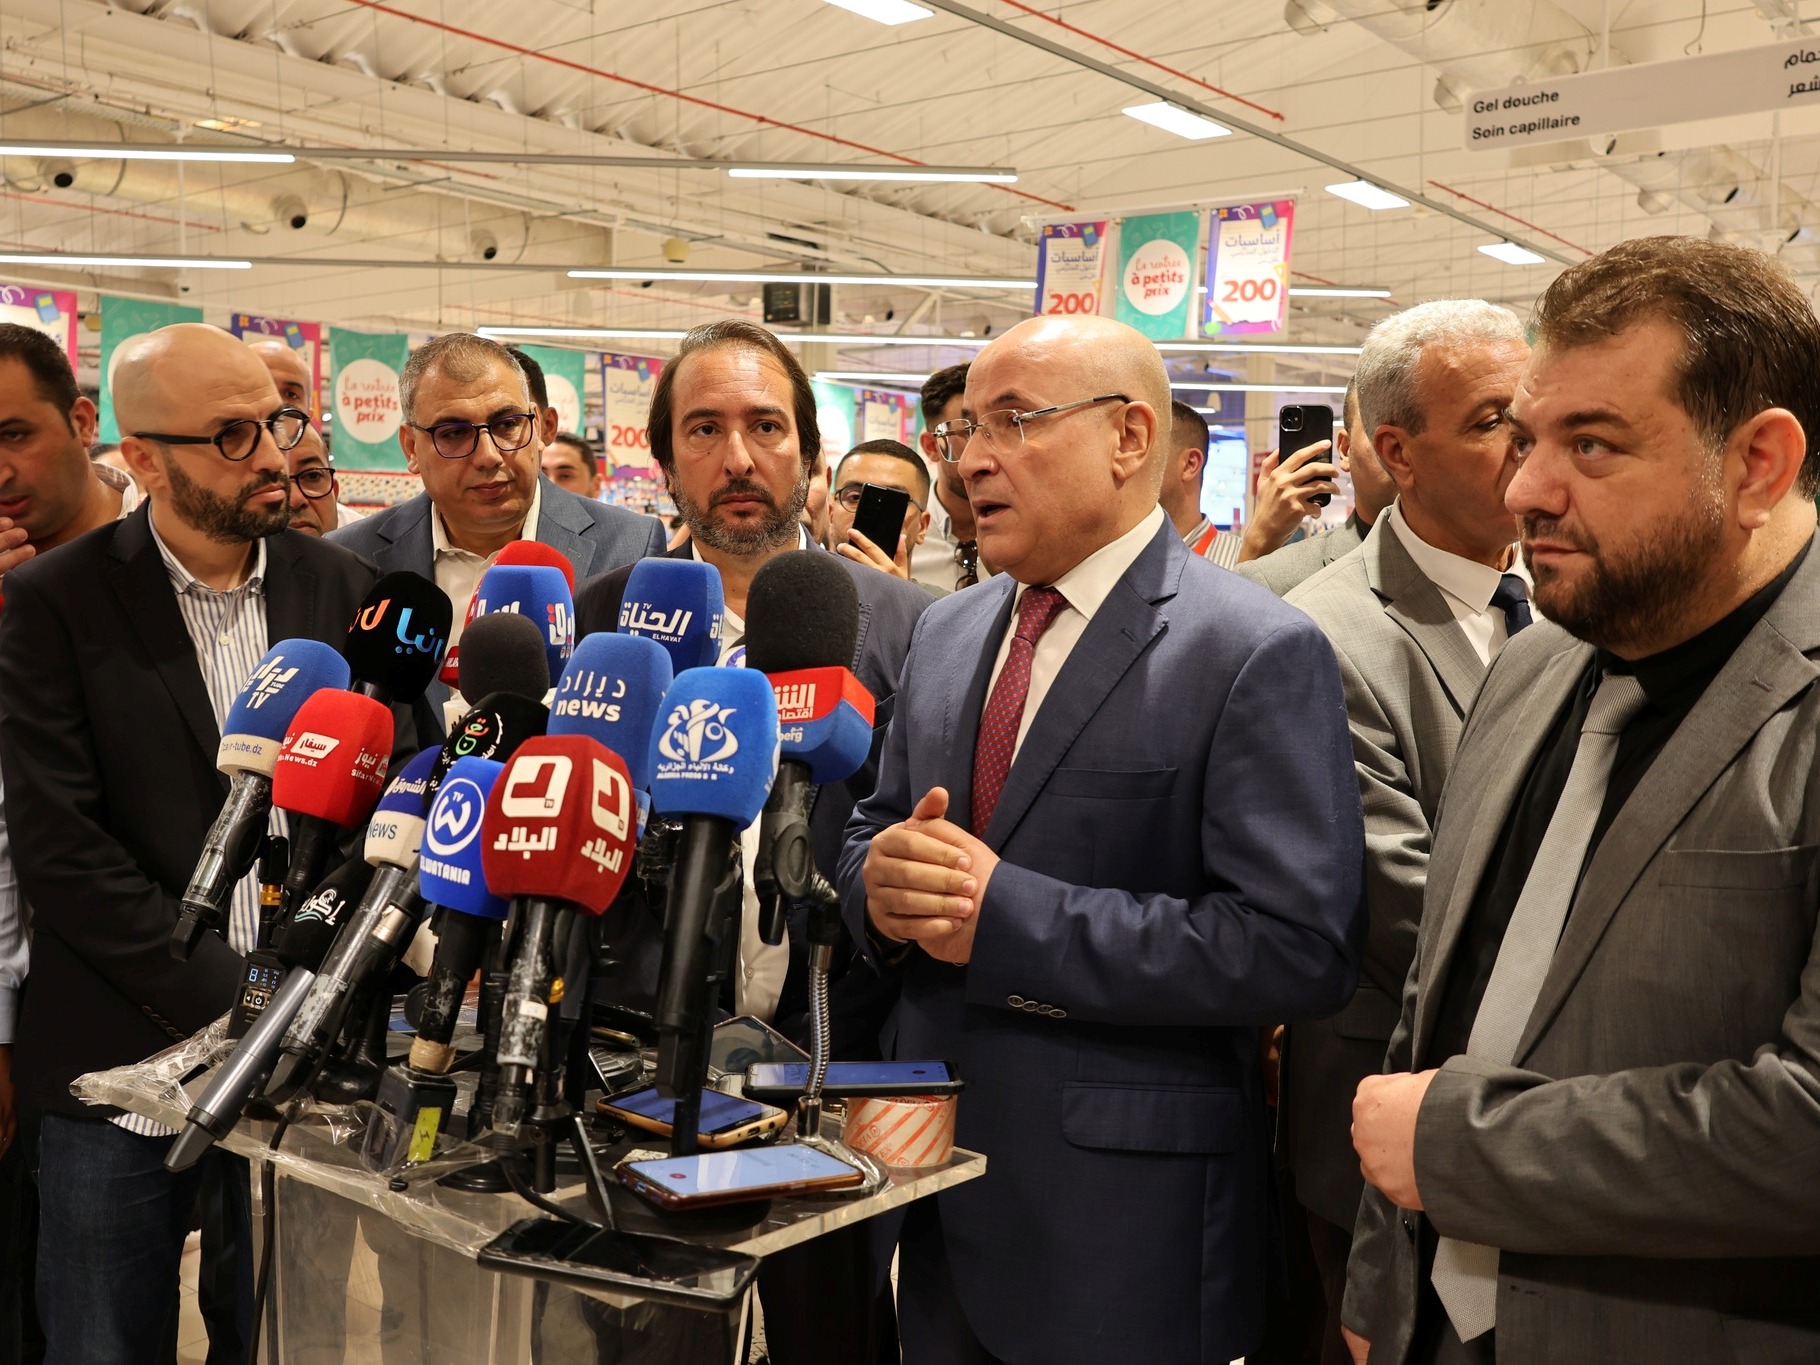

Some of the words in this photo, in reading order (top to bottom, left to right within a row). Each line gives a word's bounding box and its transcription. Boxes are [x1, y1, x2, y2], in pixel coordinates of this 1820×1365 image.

[1473, 98, 1499, 114] Gel
[1502, 91, 1559, 109] douche
[1472, 124, 1504, 140] Soin
[1509, 115, 1580, 135] capillaire
[1131, 272, 1140, 285] à
[1142, 269, 1184, 288] petits
[1222, 277, 1277, 303] 200
[1047, 292, 1095, 315] 200
[1143, 284, 1169, 300] prix
[353, 393, 398, 411] petits
[356, 407, 384, 425] prix
[246, 691, 271, 709] TV
[555, 698, 622, 722] news
[452, 791, 464, 802] TV
[493, 826, 558, 860] البلاد
[580, 837, 624, 874] البلاد
